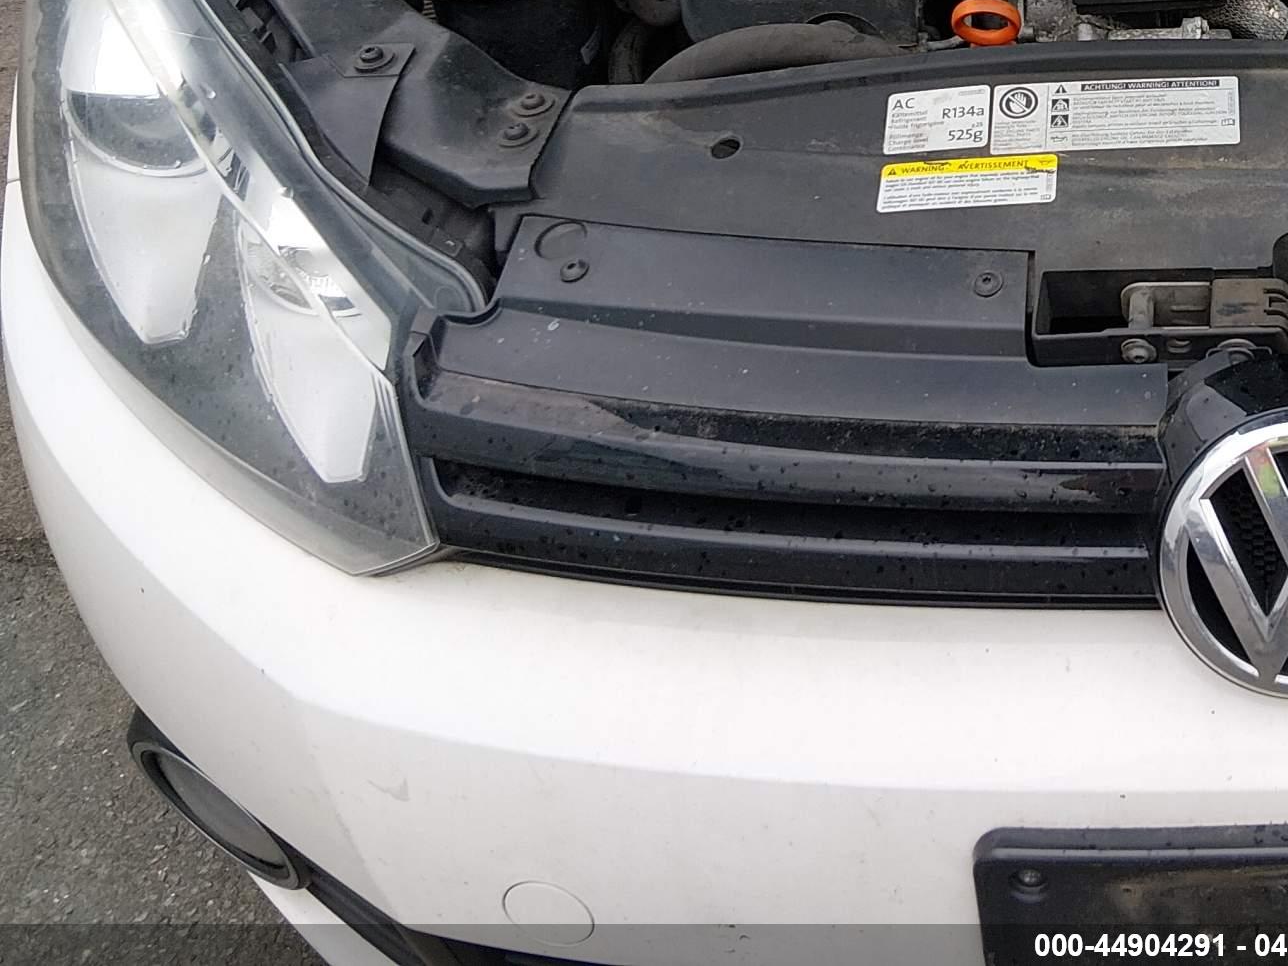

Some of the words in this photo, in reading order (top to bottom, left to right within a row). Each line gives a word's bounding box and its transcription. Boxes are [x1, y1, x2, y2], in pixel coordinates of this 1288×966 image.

[1084, 83, 1126, 91] ACHTUNG!
[1127, 81, 1169, 90] WARNING!
[1171, 80, 1217, 88] ATTENTION!
[892, 98, 915, 110] AC
[942, 105, 985, 119] R134a
[947, 128, 983, 143] 525g
[957, 160, 1029, 170] AVERTISSEMENT
